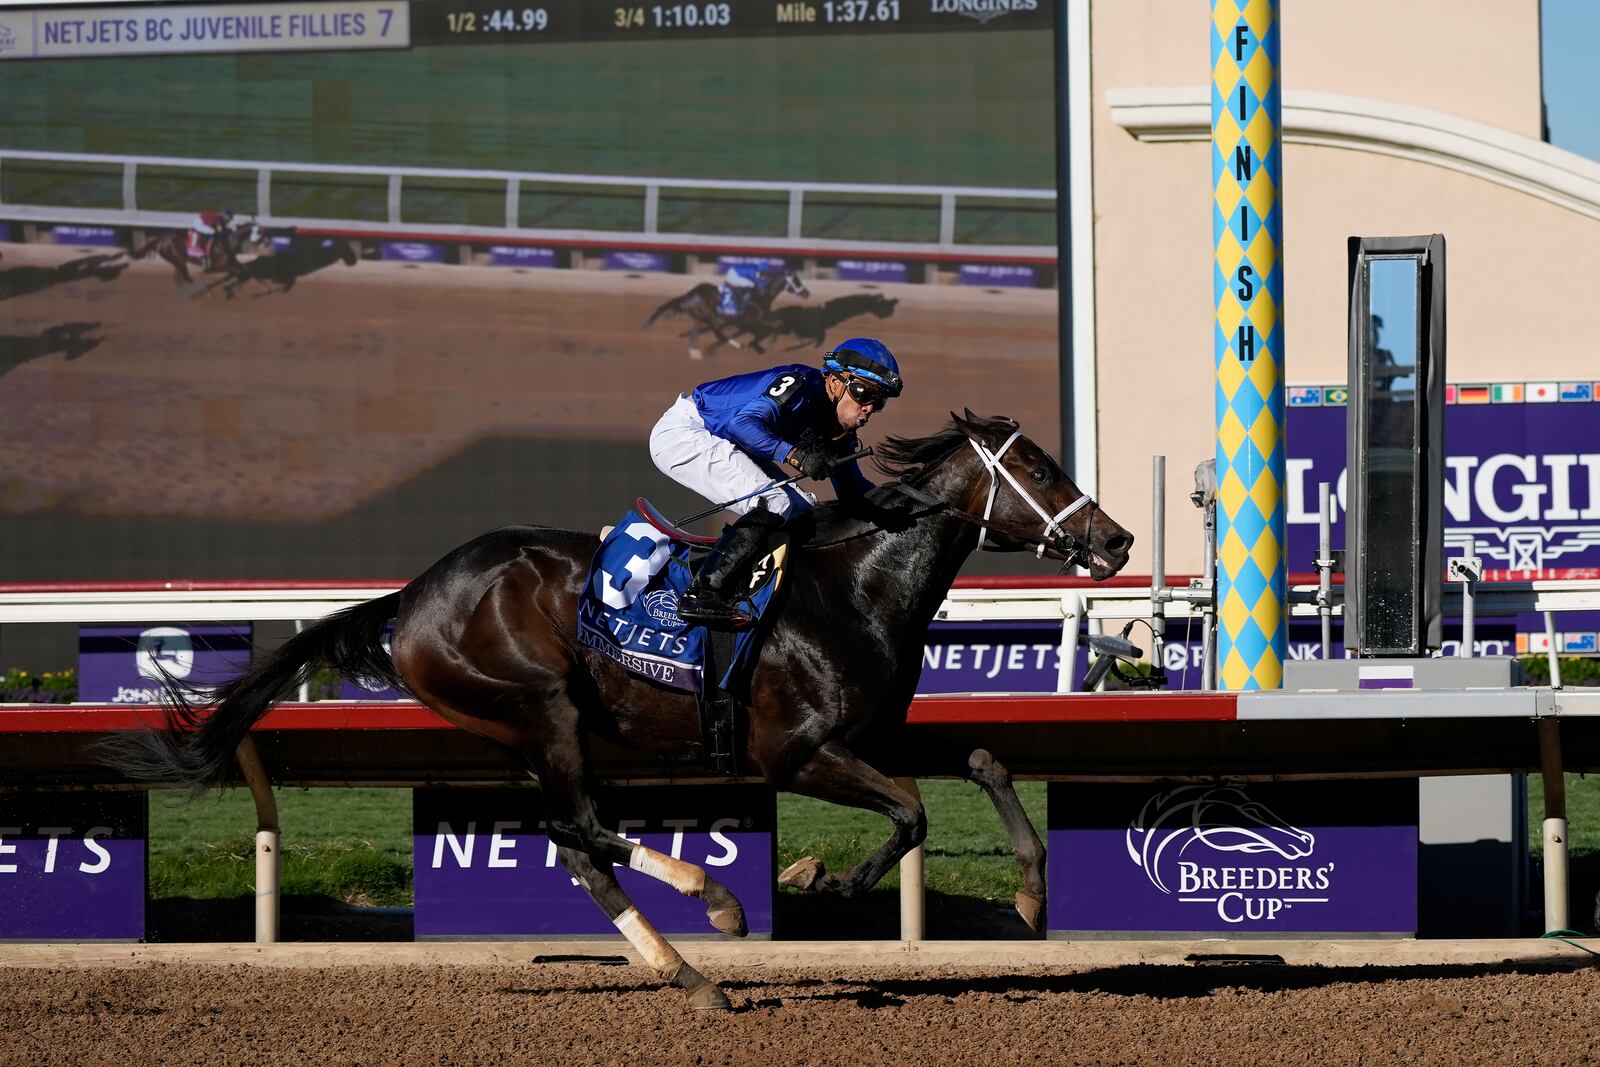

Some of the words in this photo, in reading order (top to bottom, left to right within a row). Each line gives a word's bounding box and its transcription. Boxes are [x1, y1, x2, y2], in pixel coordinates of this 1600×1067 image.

[45, 20, 138, 44] NETJETS
[145, 18, 173, 41] BC
[180, 14, 282, 40] JUVENILE
[288, 13, 366, 38] FILLIES
[377, 8, 394, 37] 7
[447, 12, 476, 32] 1/2
[482, 9, 548, 32] :44.99
[614, 8, 645, 28] 3/4
[652, 4, 730, 27] 1:10.03
[776, 4, 816, 23] Mile
[823, 1, 900, 23] 1:37.61
[1236, 26, 1255, 362] FINISH
[769, 376, 795, 396] 3
[1286, 453, 1600, 524] LNGI
[597, 522, 670, 610] 3
[580, 598, 688, 655] NETJETS
[580, 627, 675, 683] MMERSIVE
[1217, 892, 1283, 923] CUP
